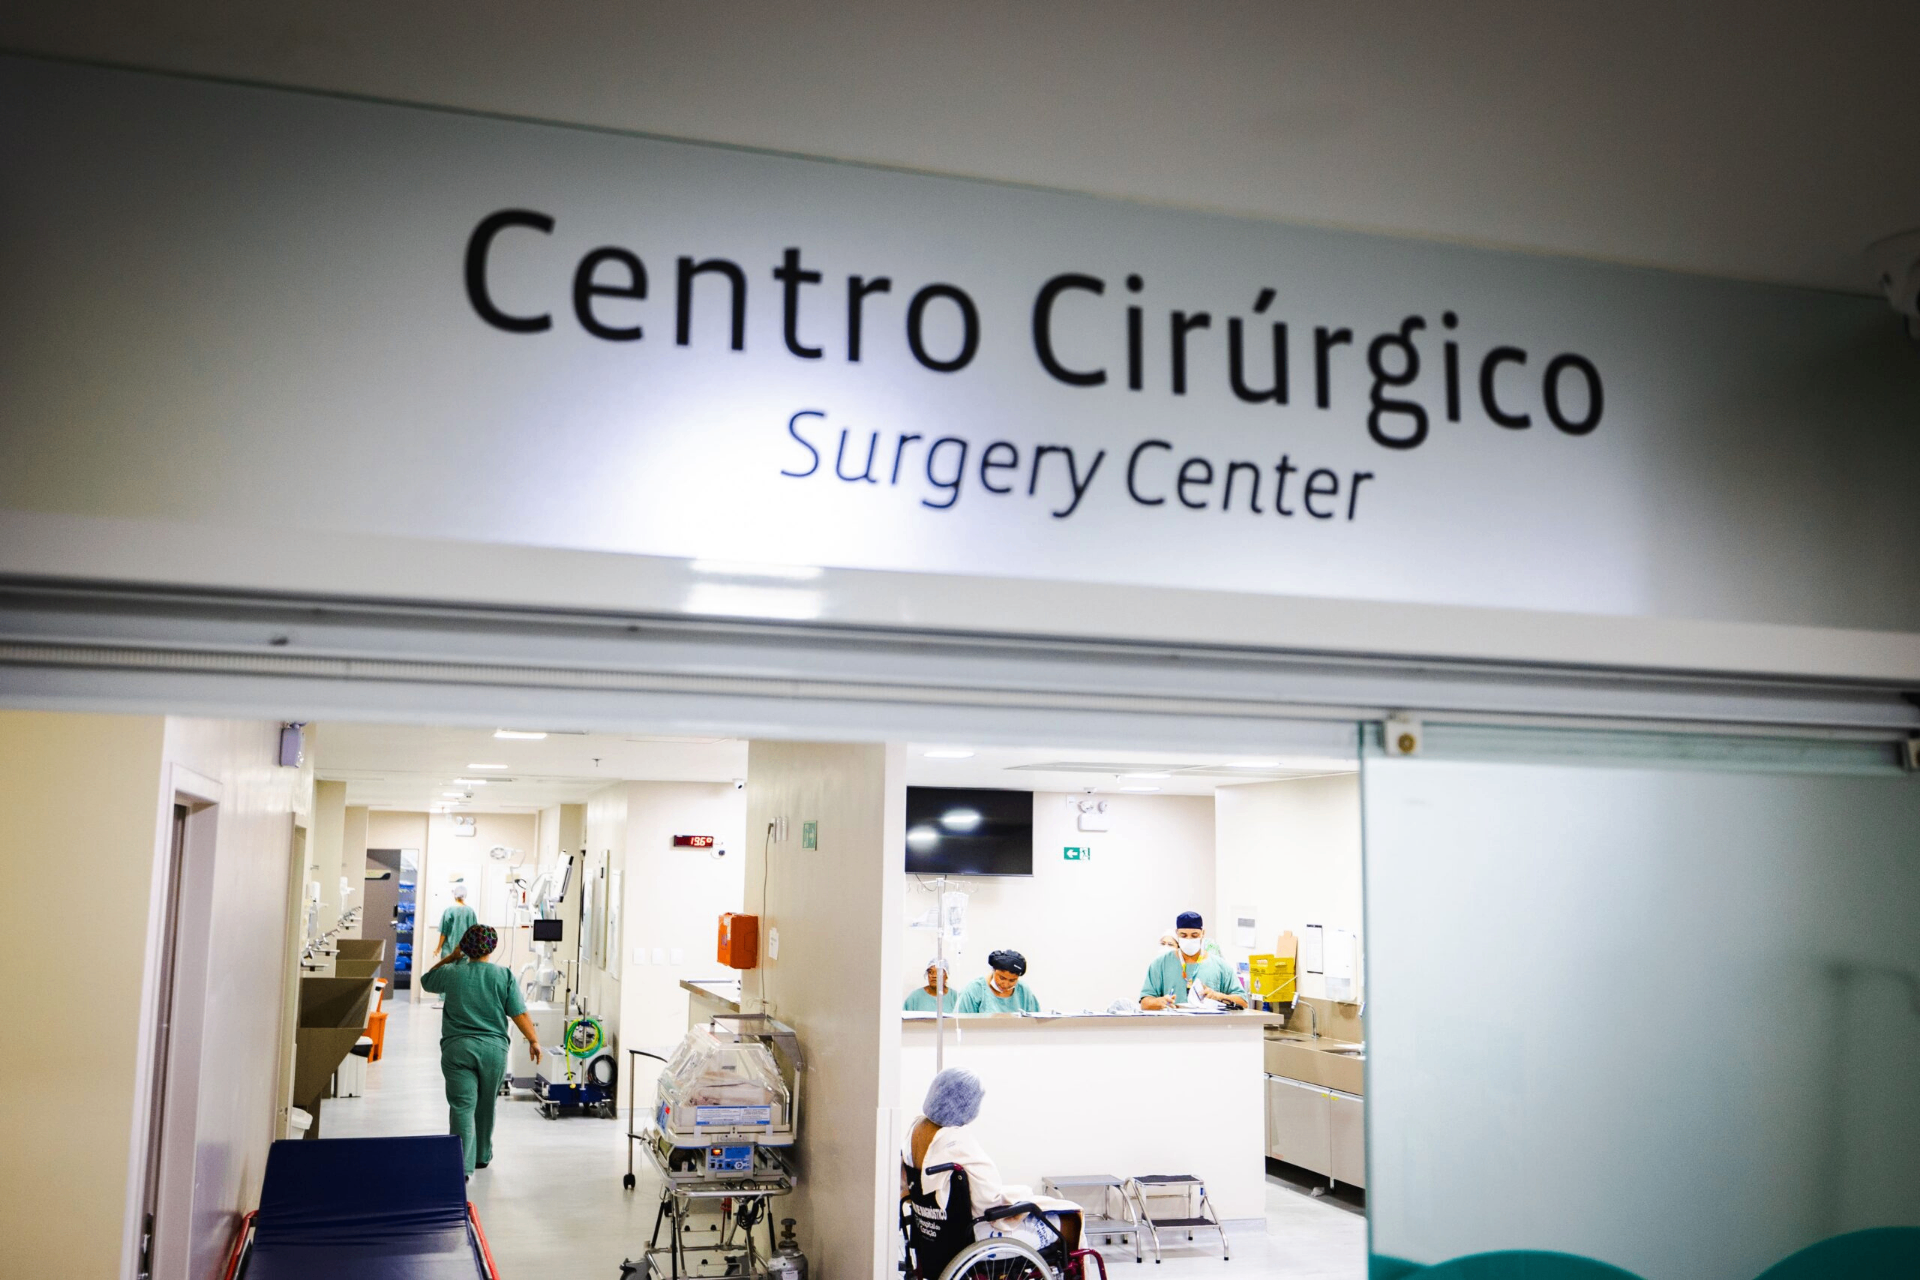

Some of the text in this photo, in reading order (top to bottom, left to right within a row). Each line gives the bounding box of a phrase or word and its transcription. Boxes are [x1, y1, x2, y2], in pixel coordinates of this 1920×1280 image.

[462, 206, 1606, 452] Centro Cirúrgico
[780, 409, 1376, 522] Surgery Center
